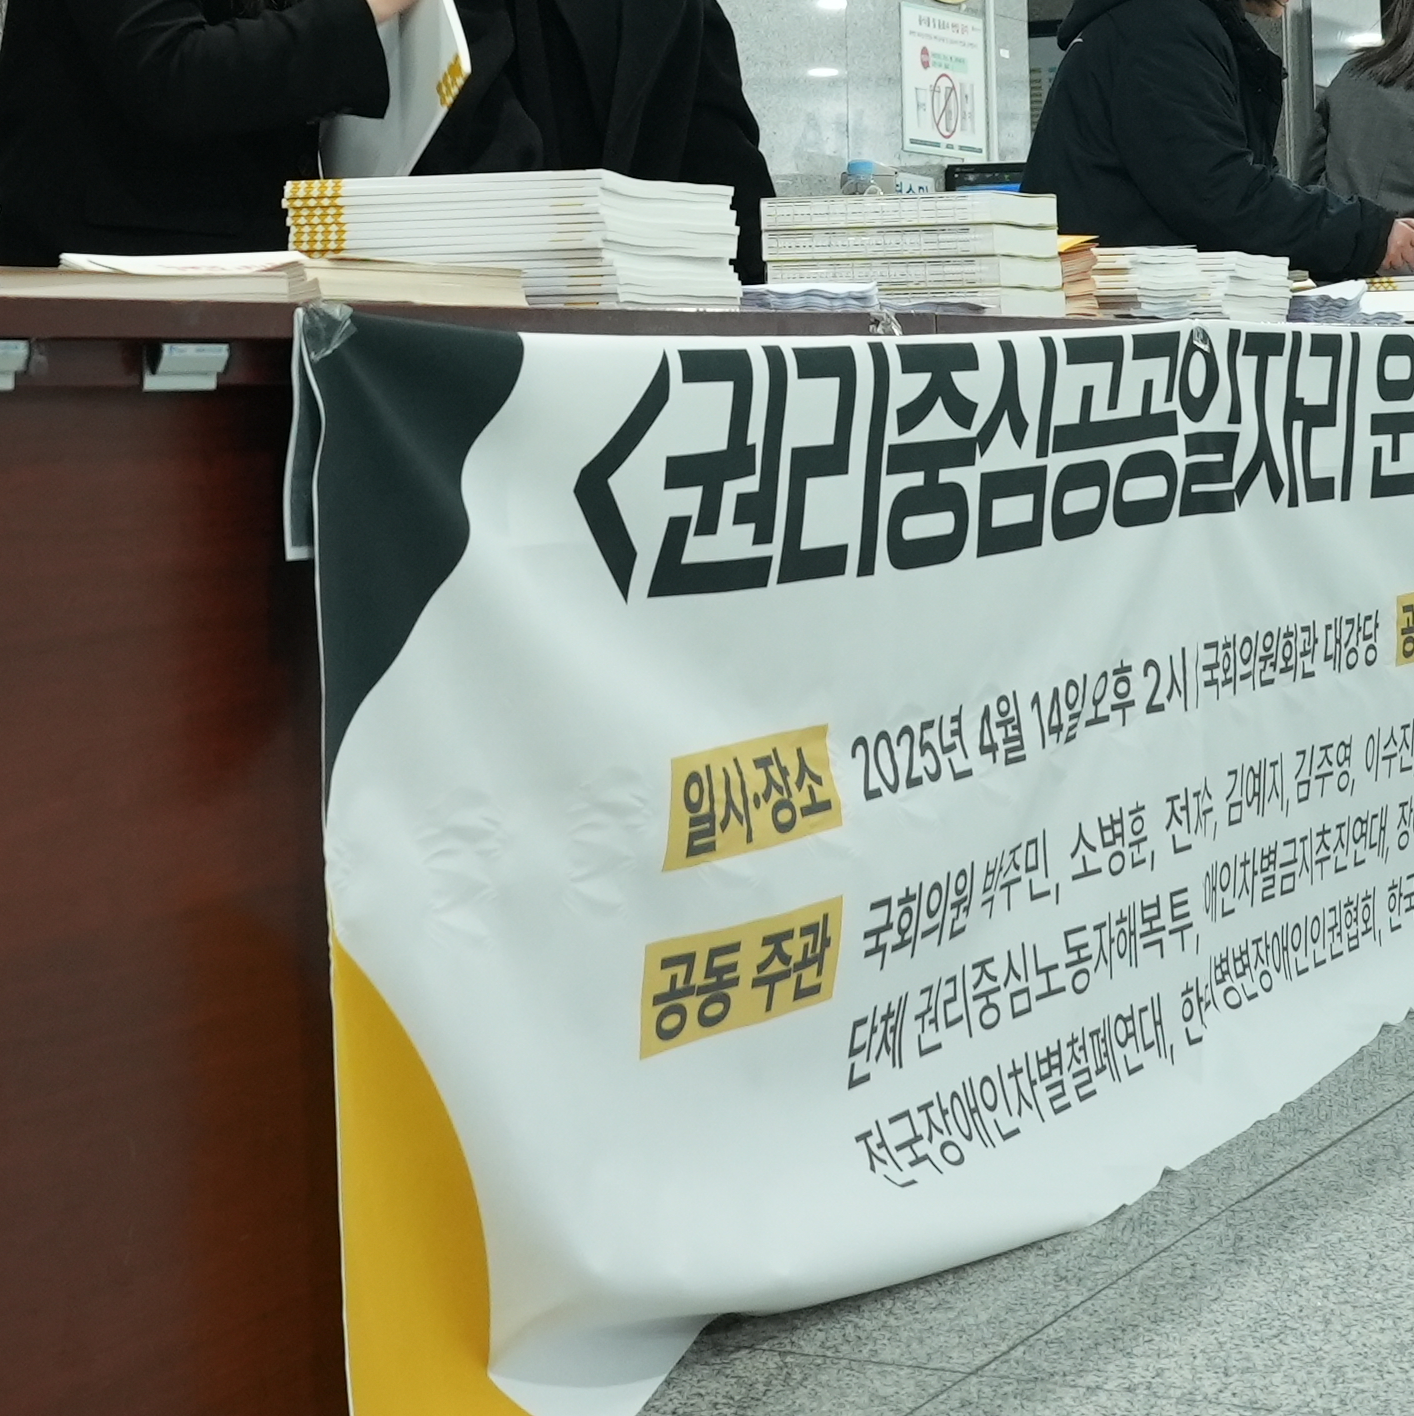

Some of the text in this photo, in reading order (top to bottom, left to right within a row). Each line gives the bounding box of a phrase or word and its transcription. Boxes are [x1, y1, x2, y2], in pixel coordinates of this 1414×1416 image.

[573, 326, 1362, 605] <권리중심공공일자리
[683, 746, 833, 859] 일시·장소
[851, 702, 973, 803] 2025년
[977, 689, 1028, 767] 4월
[1143, 644, 1189, 716] 2시
[1201, 618, 1320, 702] 국회의원회관
[1323, 608, 1380, 673] 대강당
[847, 990, 909, 1091] 단체
[914, 886, 1201, 1060] 권리중심노동자해복투,
[1201, 805, 1391, 924] 애인차별금지추진연대,
[863, 860, 976, 972] 국회의원
[1069, 799, 1156, 883] 소병훈,
[1225, 750, 1290, 827] 김예지,
[1293, 734, 1356, 805] 김주영,
[651, 912, 832, 1042] 공동 주관
[854, 991, 1177, 1190] 전국장애인차별철폐연대,
